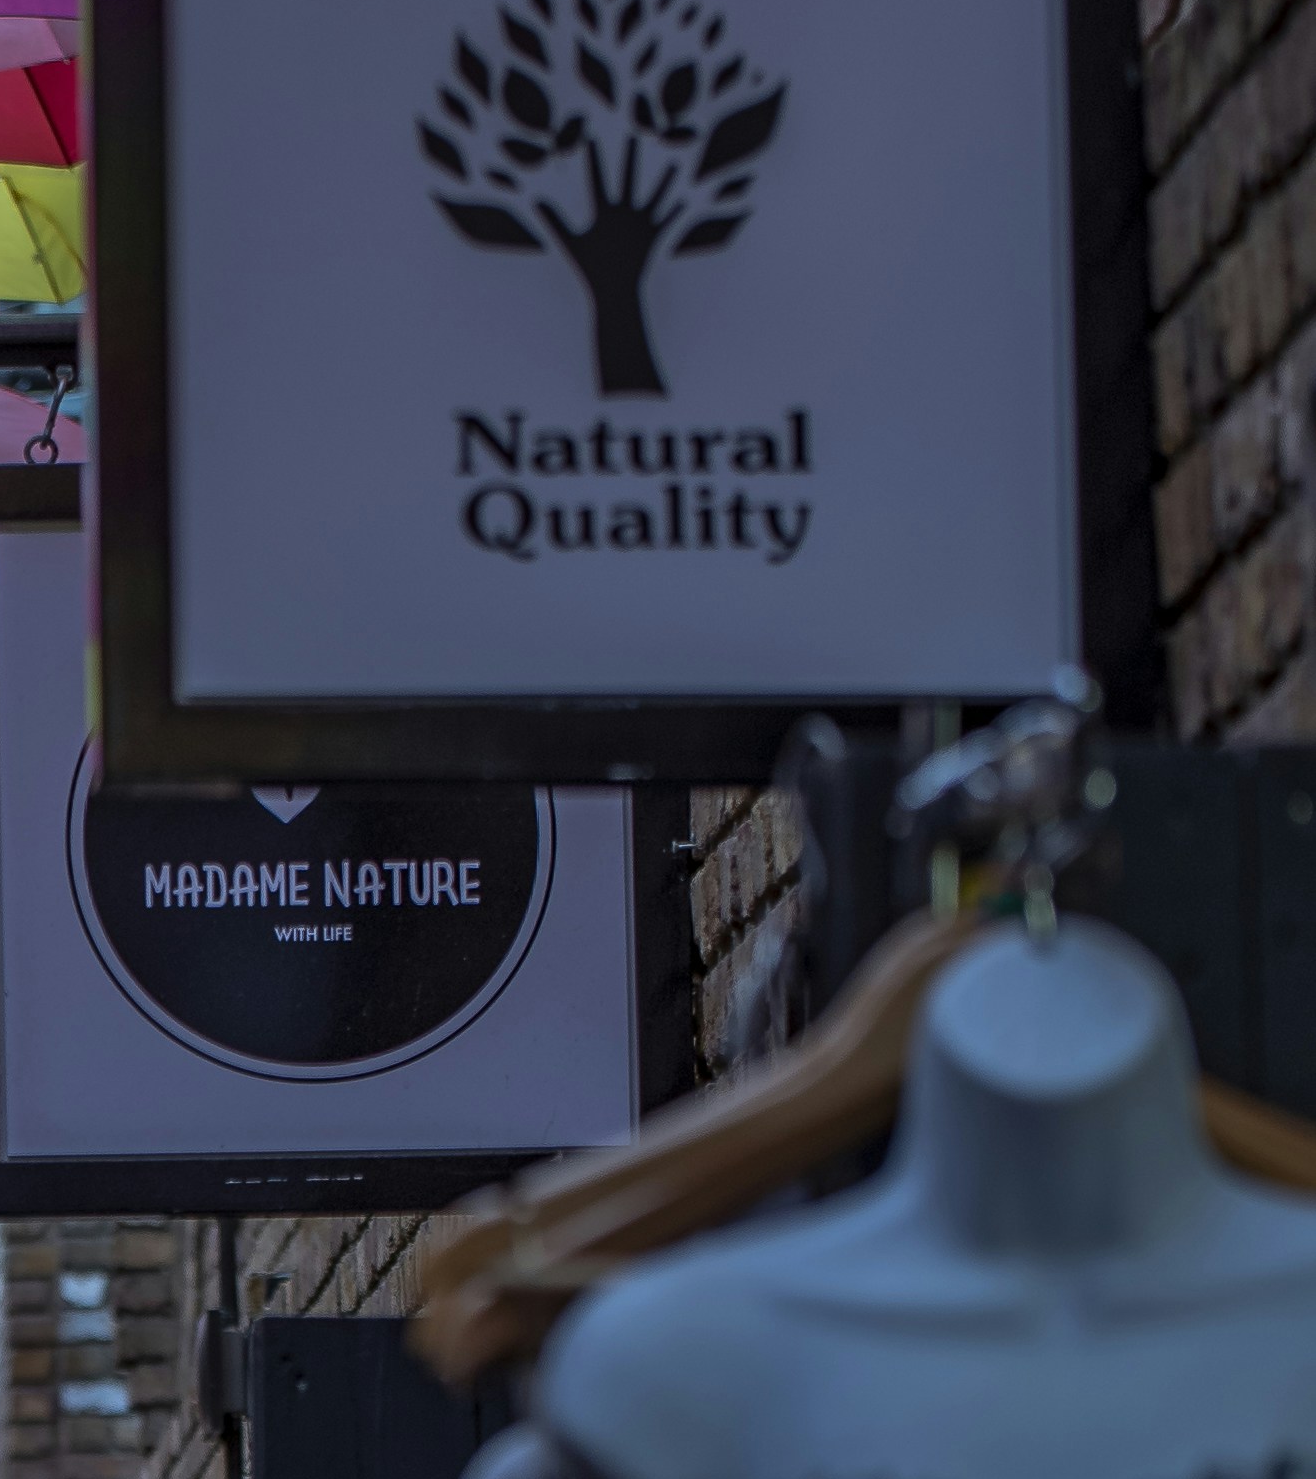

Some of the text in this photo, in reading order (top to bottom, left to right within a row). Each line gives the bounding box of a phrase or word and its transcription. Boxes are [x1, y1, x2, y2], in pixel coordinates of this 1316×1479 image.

[453, 405, 816, 478] Natural
[461, 480, 812, 566] Quality
[143, 858, 481, 908] MADAME NATURE
[273, 923, 353, 942] WITH LIFE
